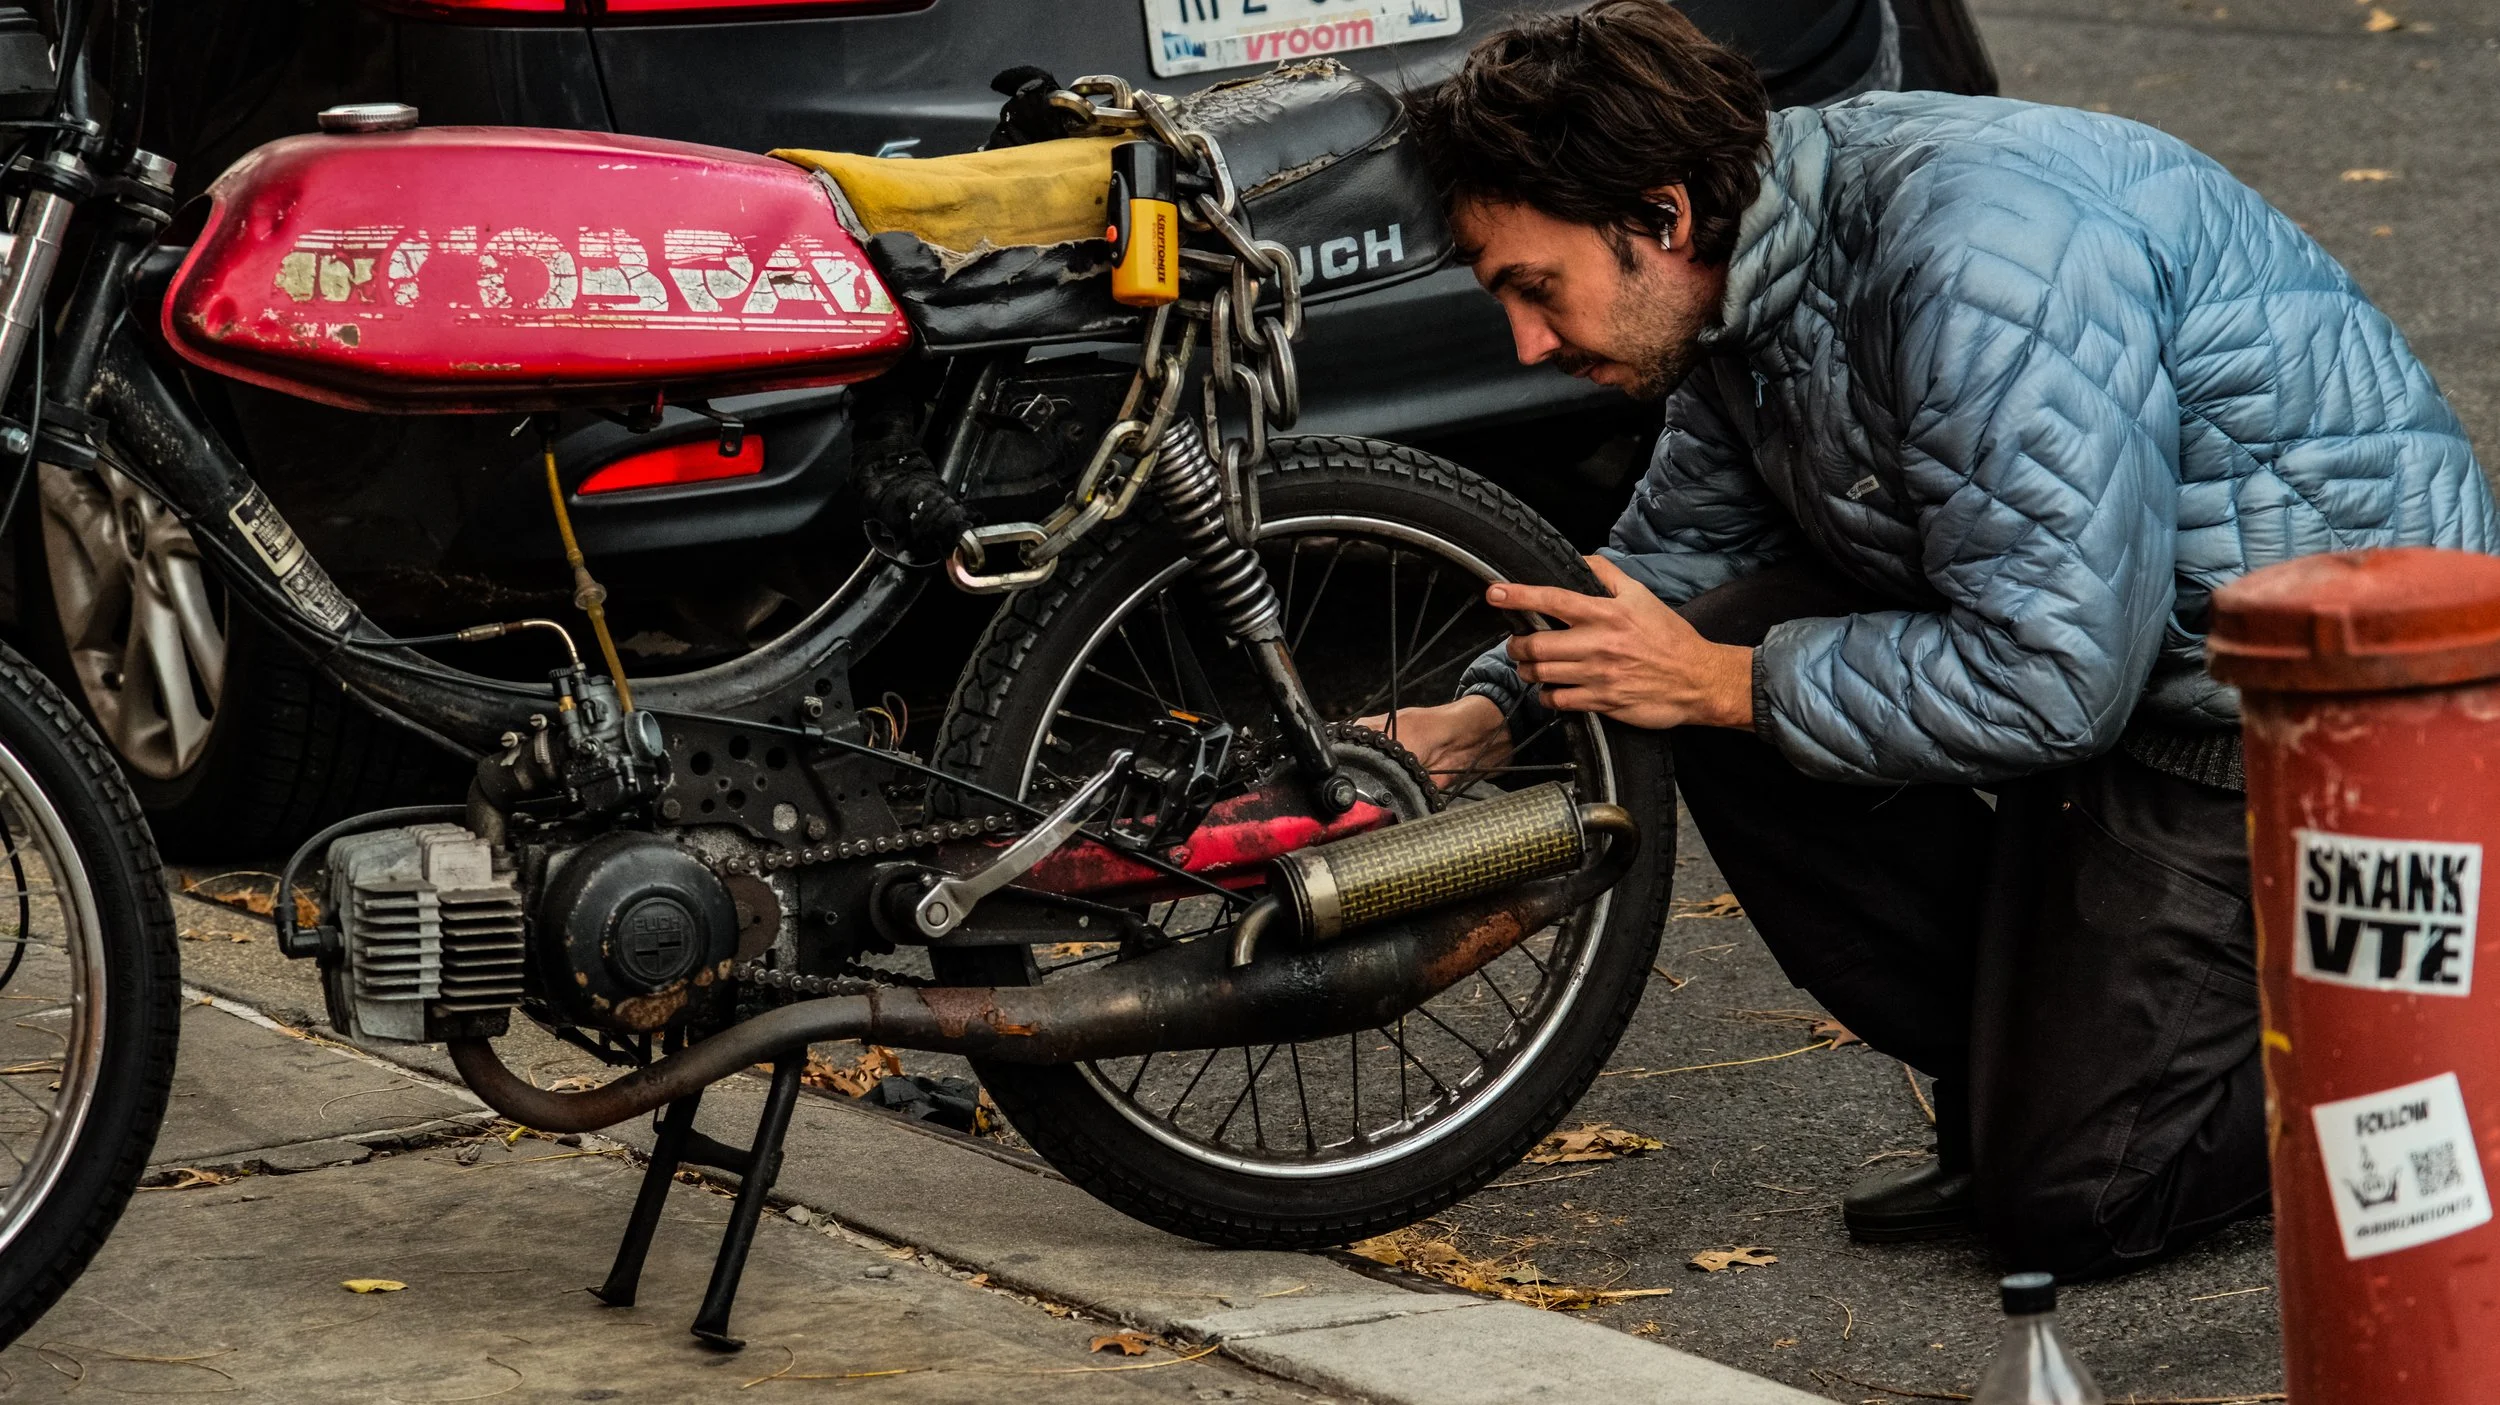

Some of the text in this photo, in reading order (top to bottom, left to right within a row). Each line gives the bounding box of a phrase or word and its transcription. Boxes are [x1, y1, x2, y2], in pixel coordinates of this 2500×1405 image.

[1246, 18, 1374, 62] vroom
[1157, 213, 1167, 285] KRYPTONITE
[1259, 222, 1405, 290] UCH
[2307, 846, 2468, 915] SKANK
[2305, 910, 2463, 986] VTE
[2356, 1099, 2429, 1137] FOLLOW
